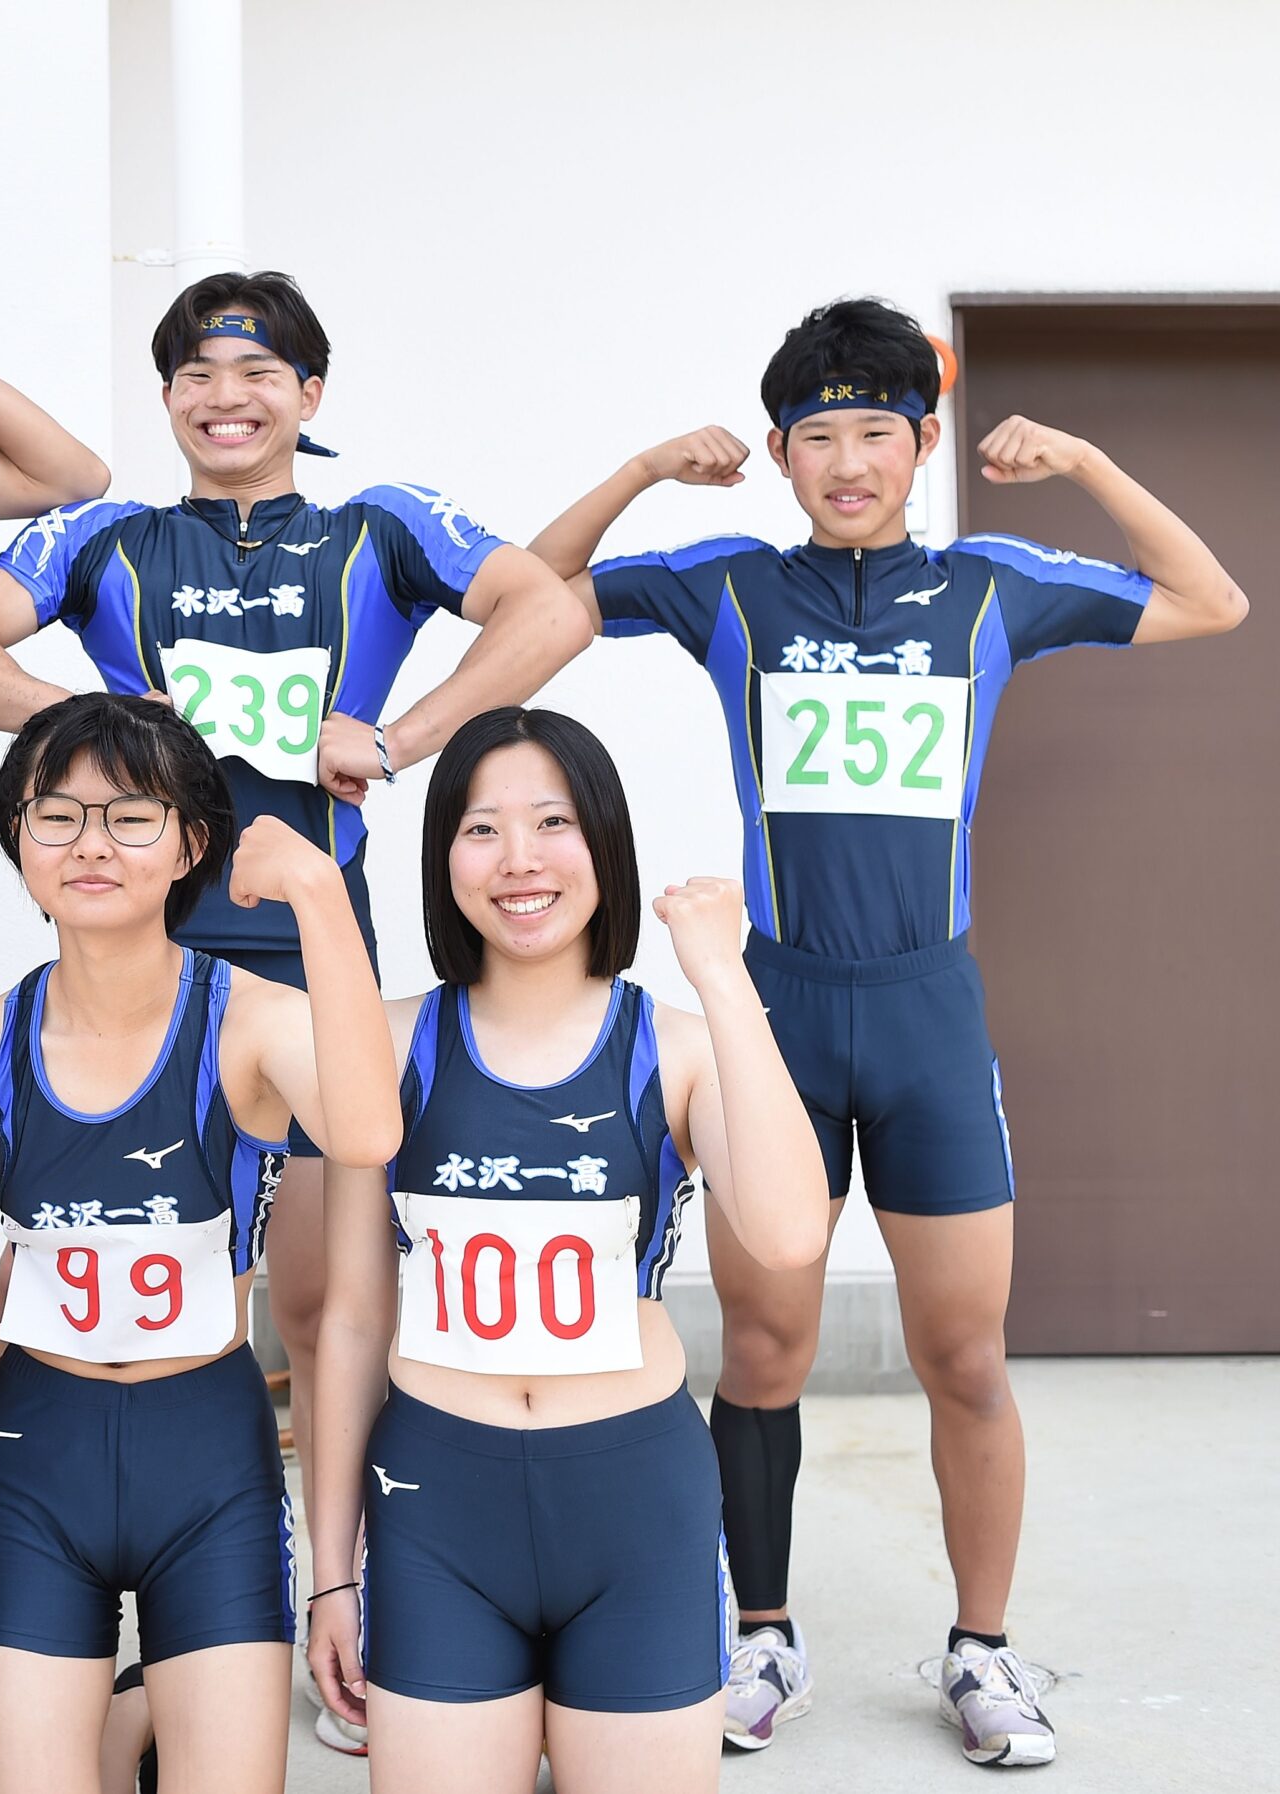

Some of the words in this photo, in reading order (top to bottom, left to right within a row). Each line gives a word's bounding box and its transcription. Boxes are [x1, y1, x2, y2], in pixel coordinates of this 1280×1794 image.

[171, 584, 306, 618] 水沢一高
[780, 635, 932, 676] 水沢一高
[170, 664, 320, 755] 239
[785, 699, 945, 790] 252
[432, 1153, 609, 1195] 水沢一高
[31, 1194, 180, 1229] 水沢一高
[56, 1246, 183, 1333] 99
[426, 1228, 596, 1340] 100
